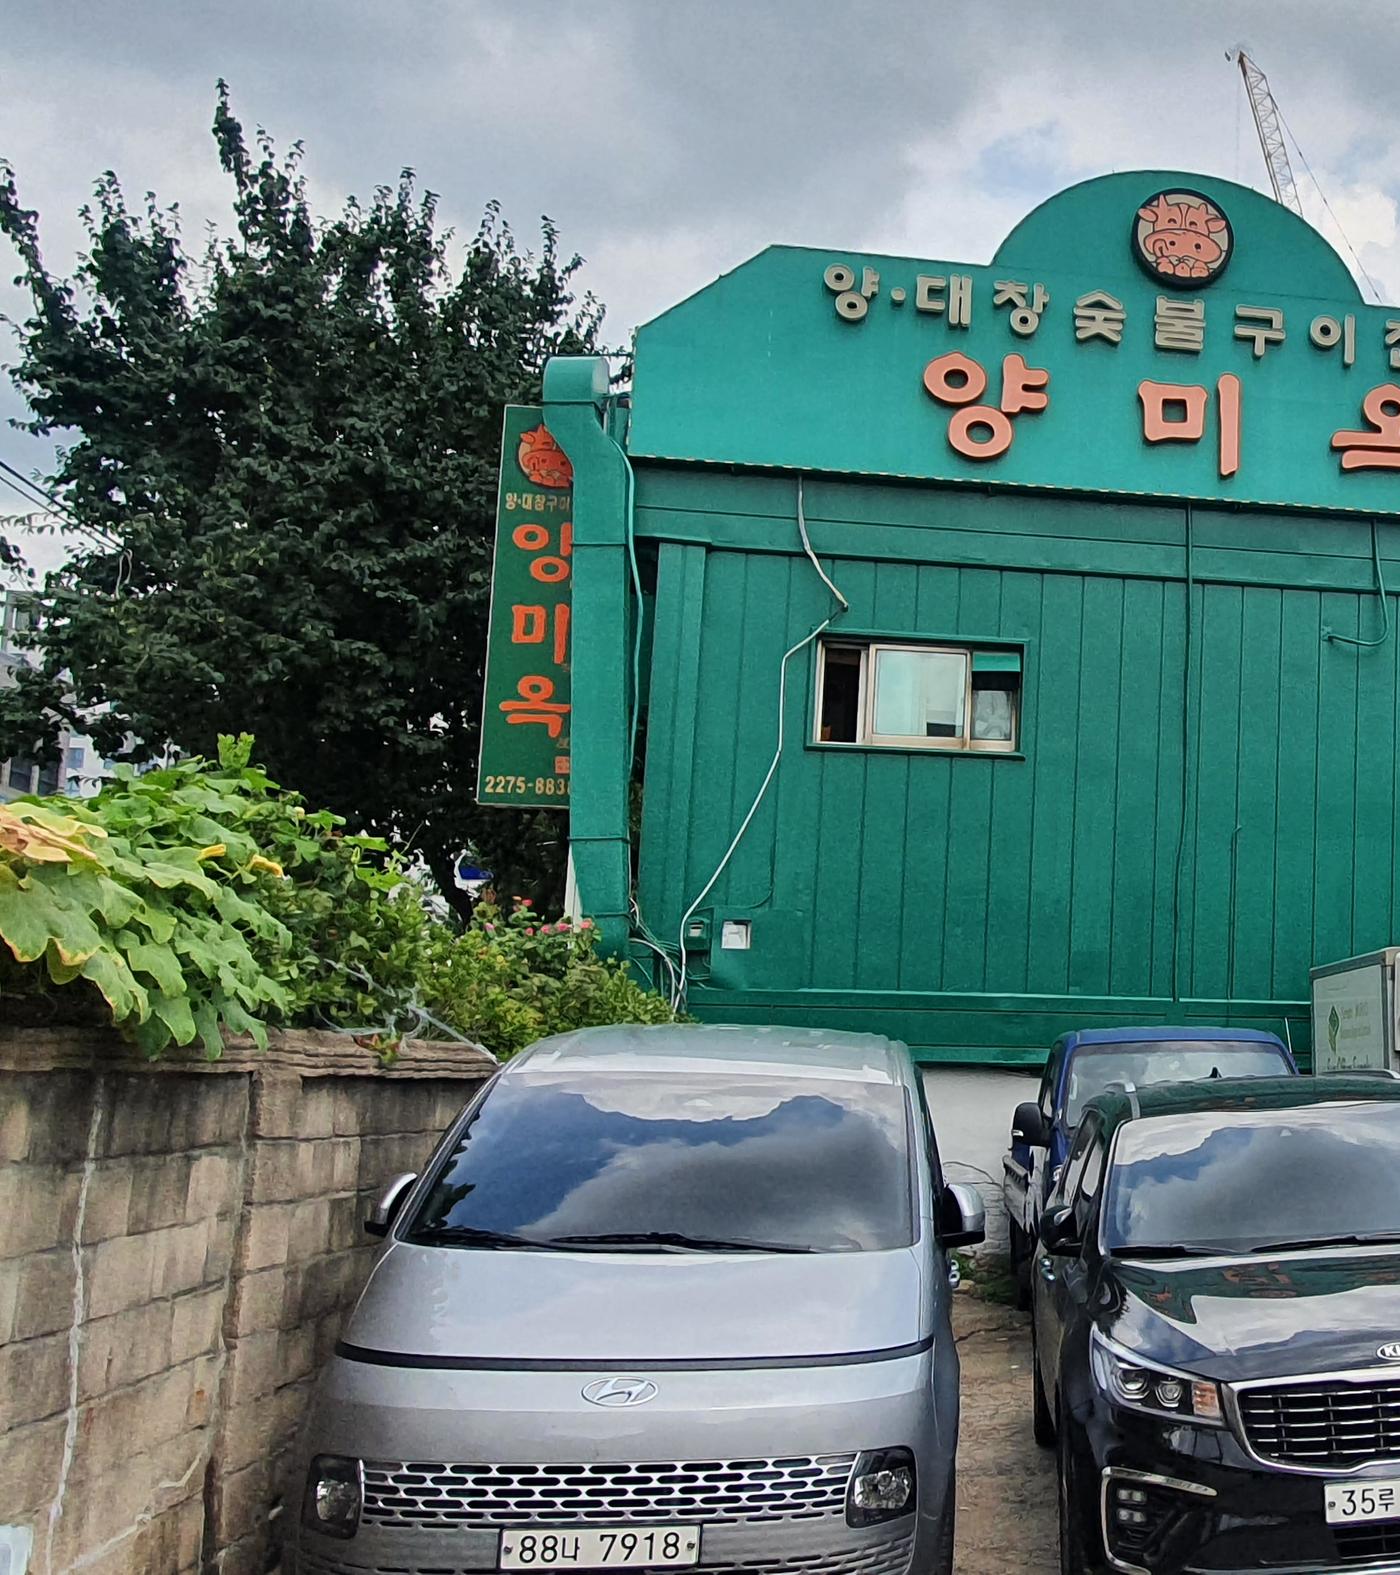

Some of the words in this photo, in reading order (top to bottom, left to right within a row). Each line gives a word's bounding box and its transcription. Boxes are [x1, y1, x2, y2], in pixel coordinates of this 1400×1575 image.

[485, 775, 570, 796] 2275-883
[1341, 1488, 1394, 1516] 35루
[518, 1534, 580, 1564] 88나
[599, 1531, 681, 1562] 7918
